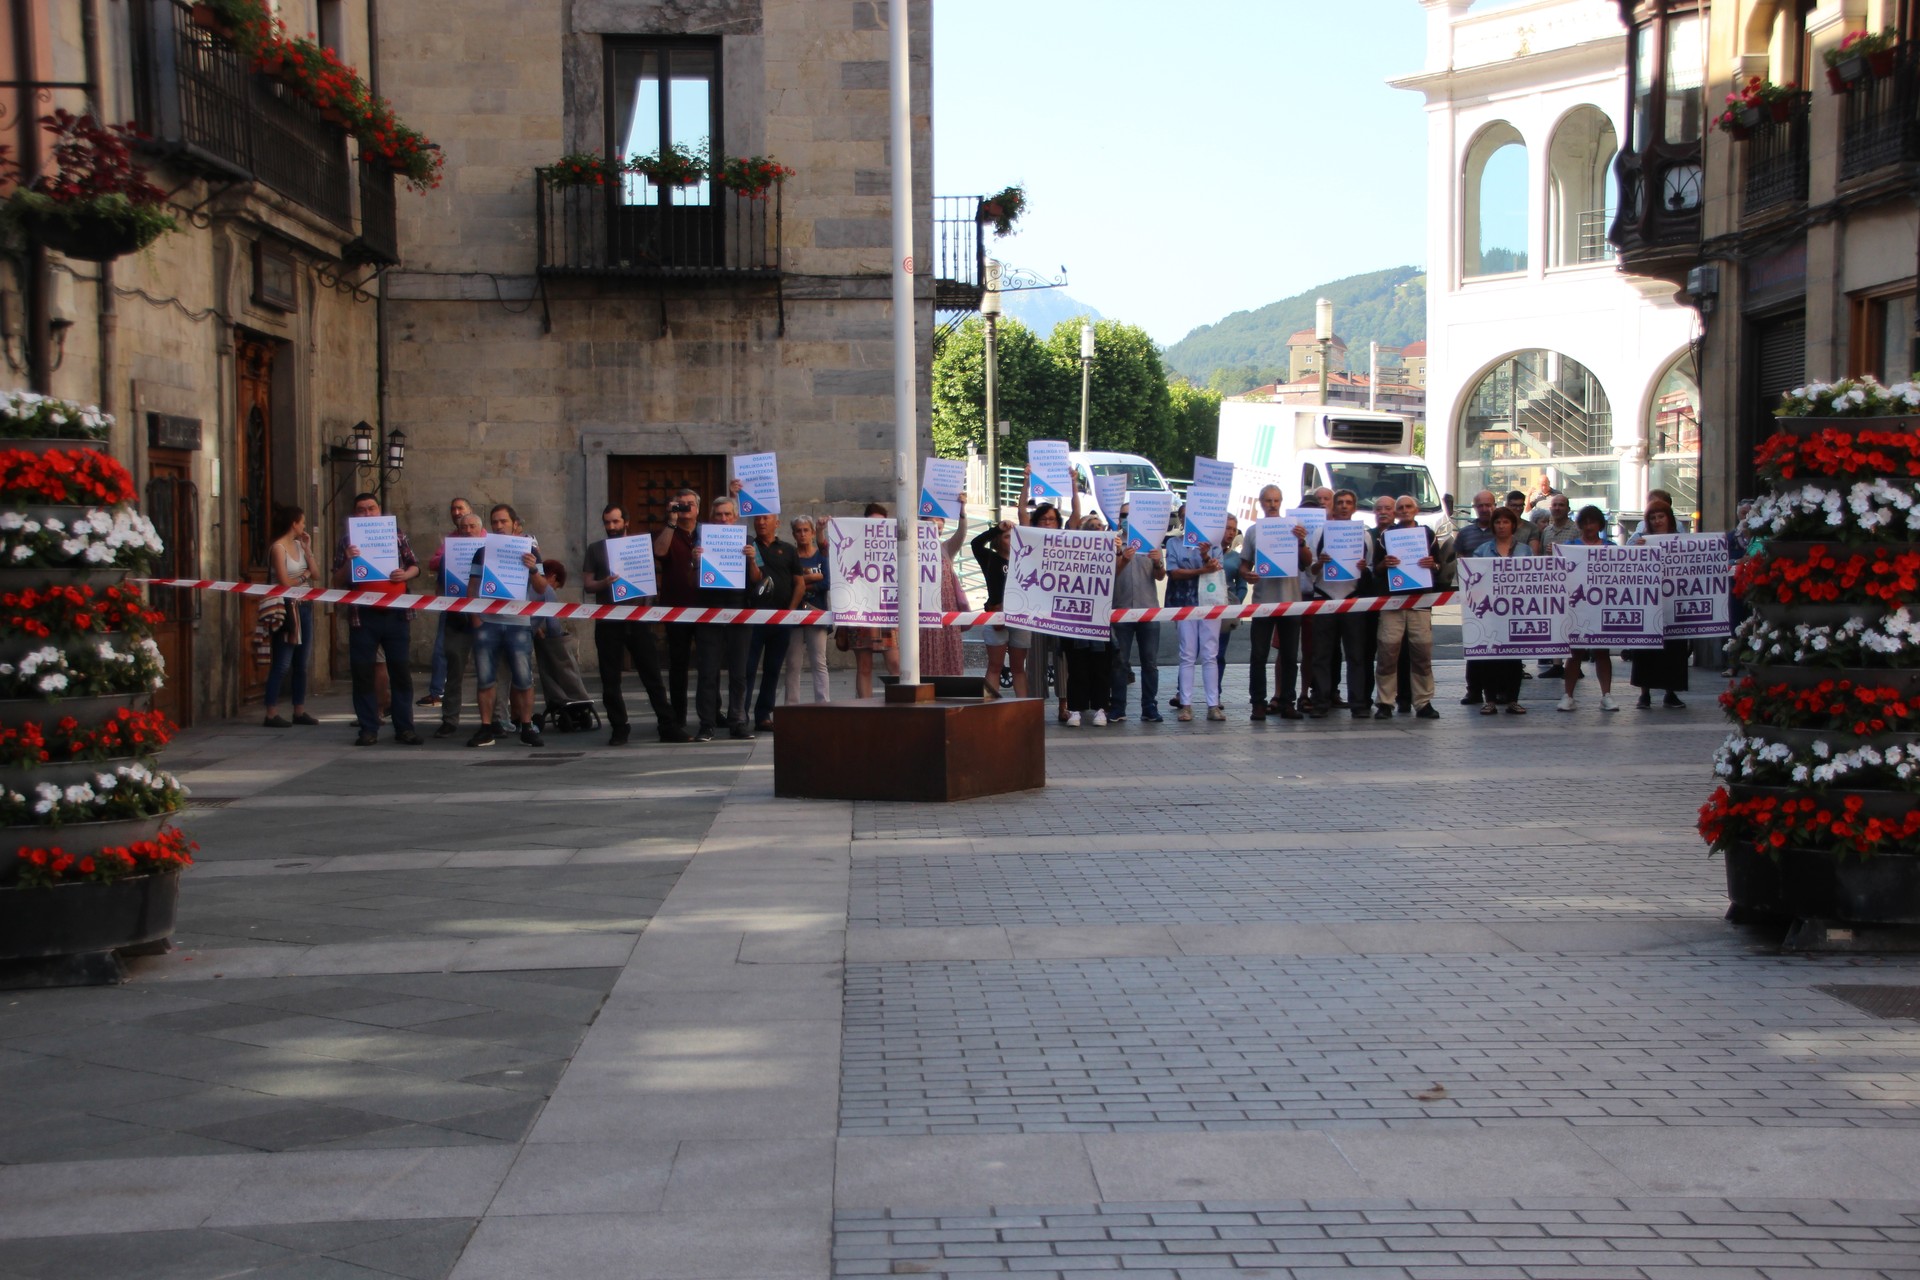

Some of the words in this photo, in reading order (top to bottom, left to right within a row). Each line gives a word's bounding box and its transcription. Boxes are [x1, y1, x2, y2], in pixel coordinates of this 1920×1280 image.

[864, 524, 937, 539] HELEN
[864, 540, 937, 550] EGOITAKO
[864, 552, 937, 562] HITZAENA
[1043, 549, 1114, 562] EGOITZETAKO
[1042, 560, 1112, 575] HITZARMENA
[1493, 558, 1566, 572] HELDUEN
[1587, 563, 1660, 573] EGOITZETAKO
[864, 564, 936, 583] ORN
[1493, 573, 1566, 583] EGOITZETAKO
[1587, 575, 1660, 585] HITZARMENA
[1040, 573, 1110, 596] ORAIN
[1493, 584, 1566, 595] HITZARMENA
[1662, 576, 1726, 597] ORAIN
[1587, 587, 1658, 605] ORAIN
[1055, 599, 1091, 614] LAB
[1493, 597, 1565, 616] ORAIN
[1676, 601, 1710, 615] LAB
[1604, 612, 1641, 624] LAB
[1006, 615, 1037, 626] EMAKUME
[1039, 622, 1073, 632] LANGILEOK
[1075, 627, 1110, 636] BORROKAN
[1511, 621, 1548, 634] LAB
[1698, 625, 1729, 633] BORROKAN
